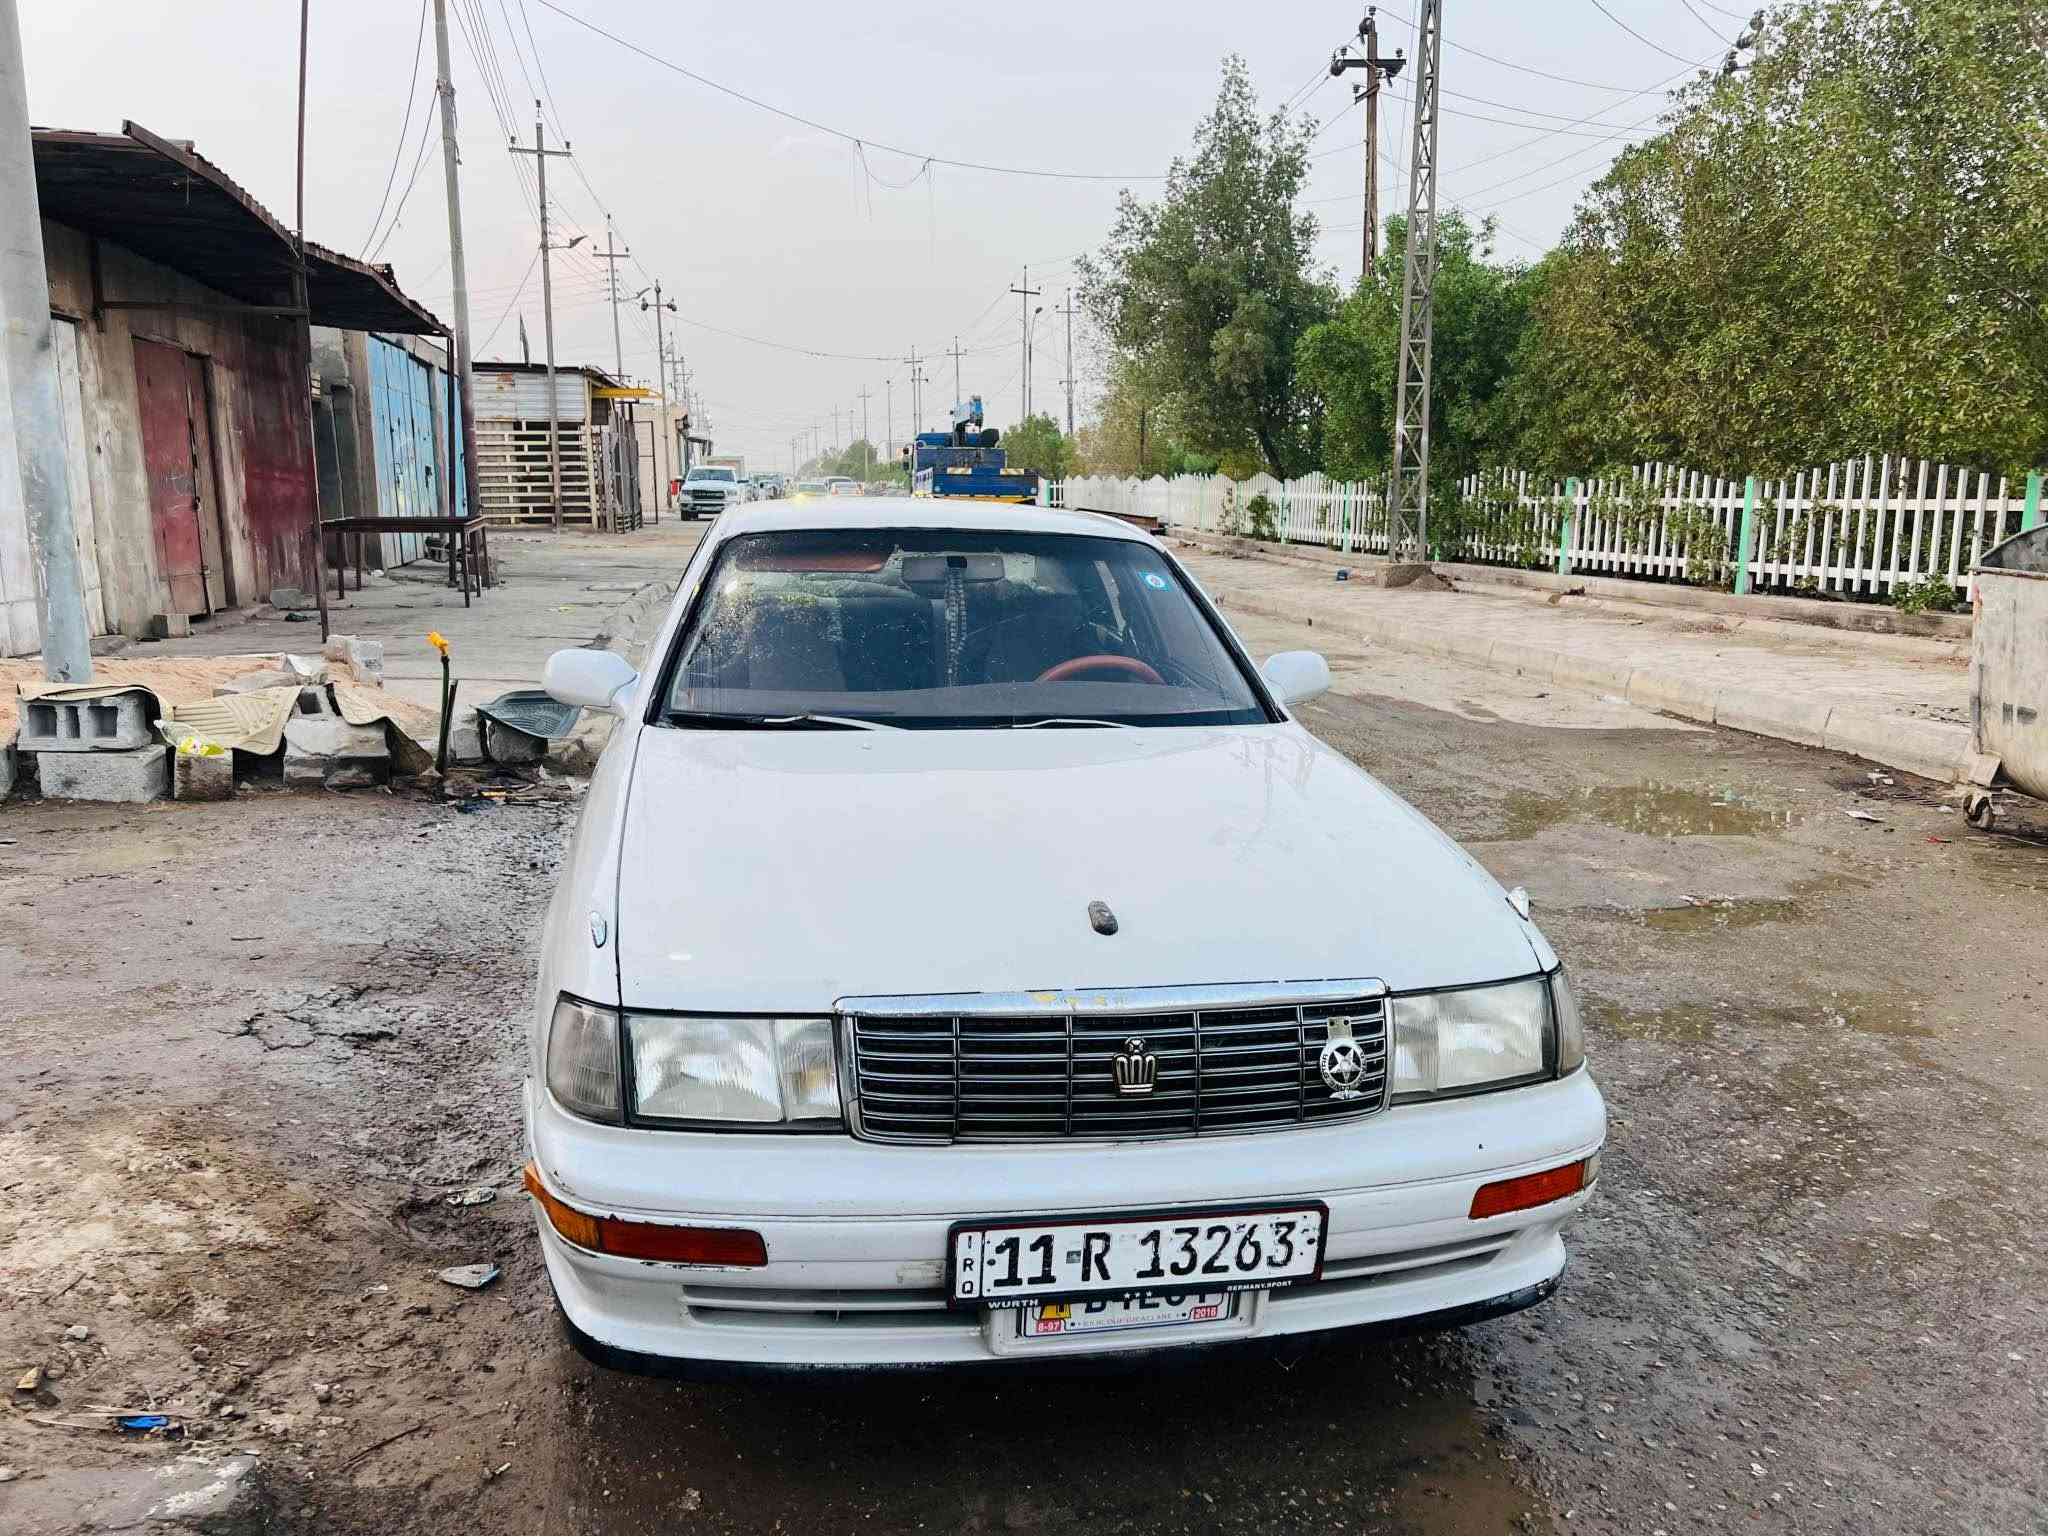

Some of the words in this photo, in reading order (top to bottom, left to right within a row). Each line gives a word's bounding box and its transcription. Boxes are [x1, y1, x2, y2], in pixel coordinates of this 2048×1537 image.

[962, 1235, 974, 1295] IRQ
[994, 1233, 1057, 1288] 11
[1081, 1231, 1112, 1282] R
[1136, 1220, 1297, 1279] 13263
